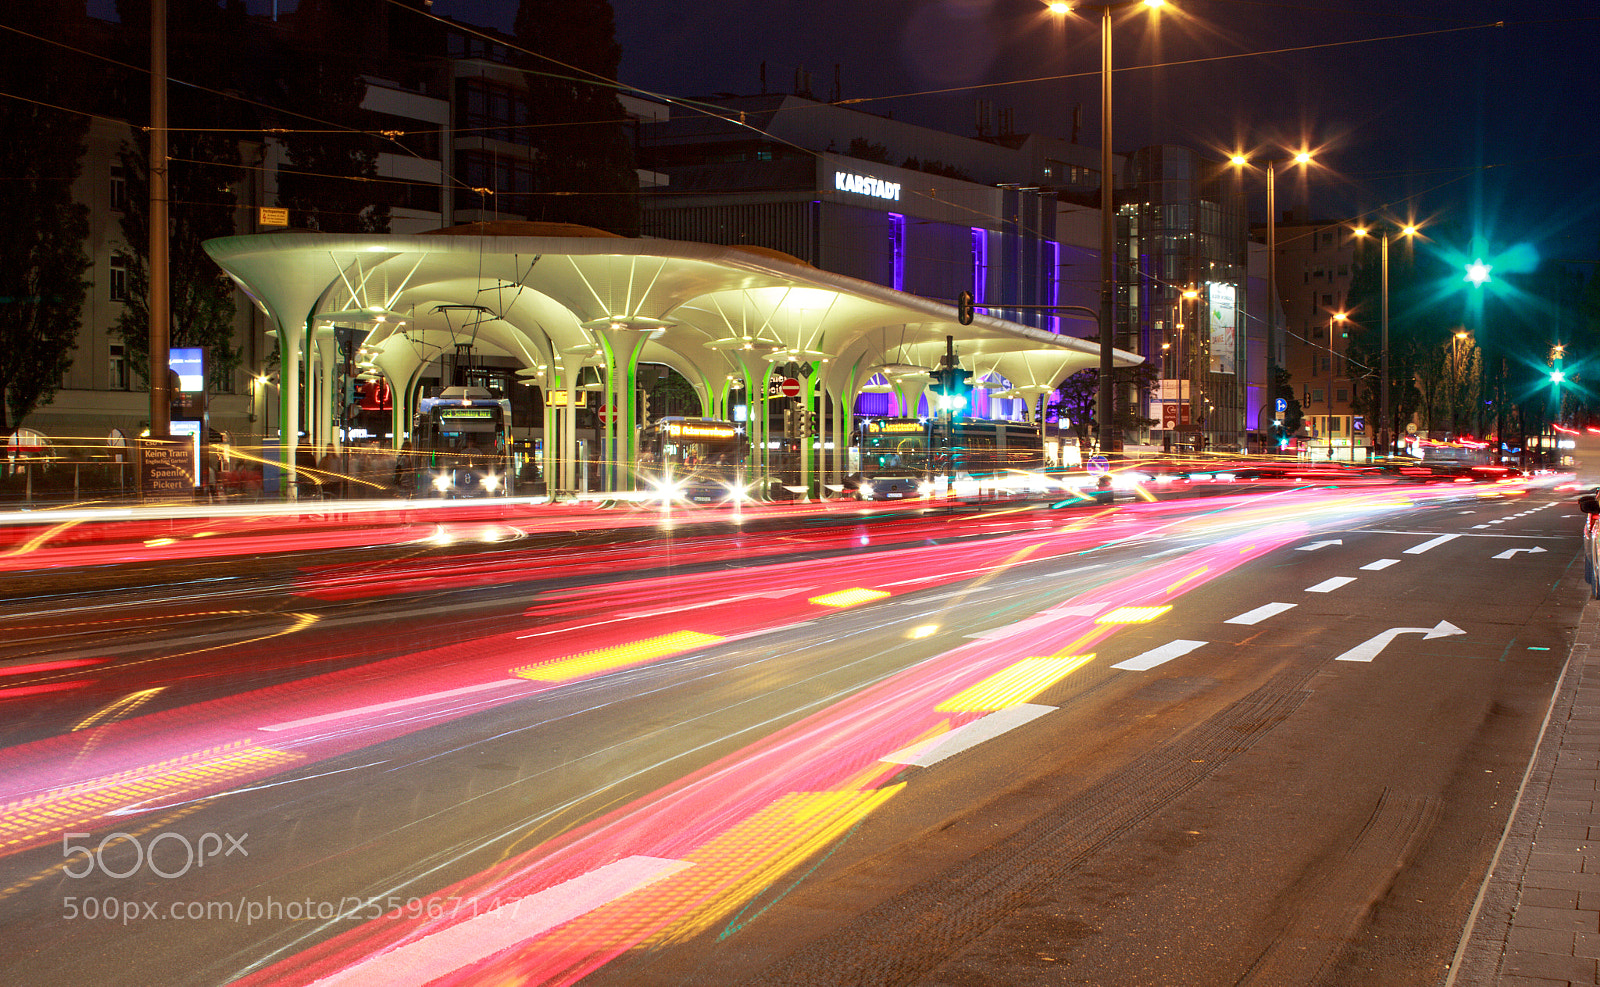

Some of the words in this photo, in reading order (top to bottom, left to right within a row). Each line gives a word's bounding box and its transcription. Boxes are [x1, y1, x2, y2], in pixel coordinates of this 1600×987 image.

[836, 171, 901, 201] KARSTADT
[145, 450, 167, 458] Keine
[168, 449, 188, 458] Tram
[153, 481, 183, 489] Pickert
